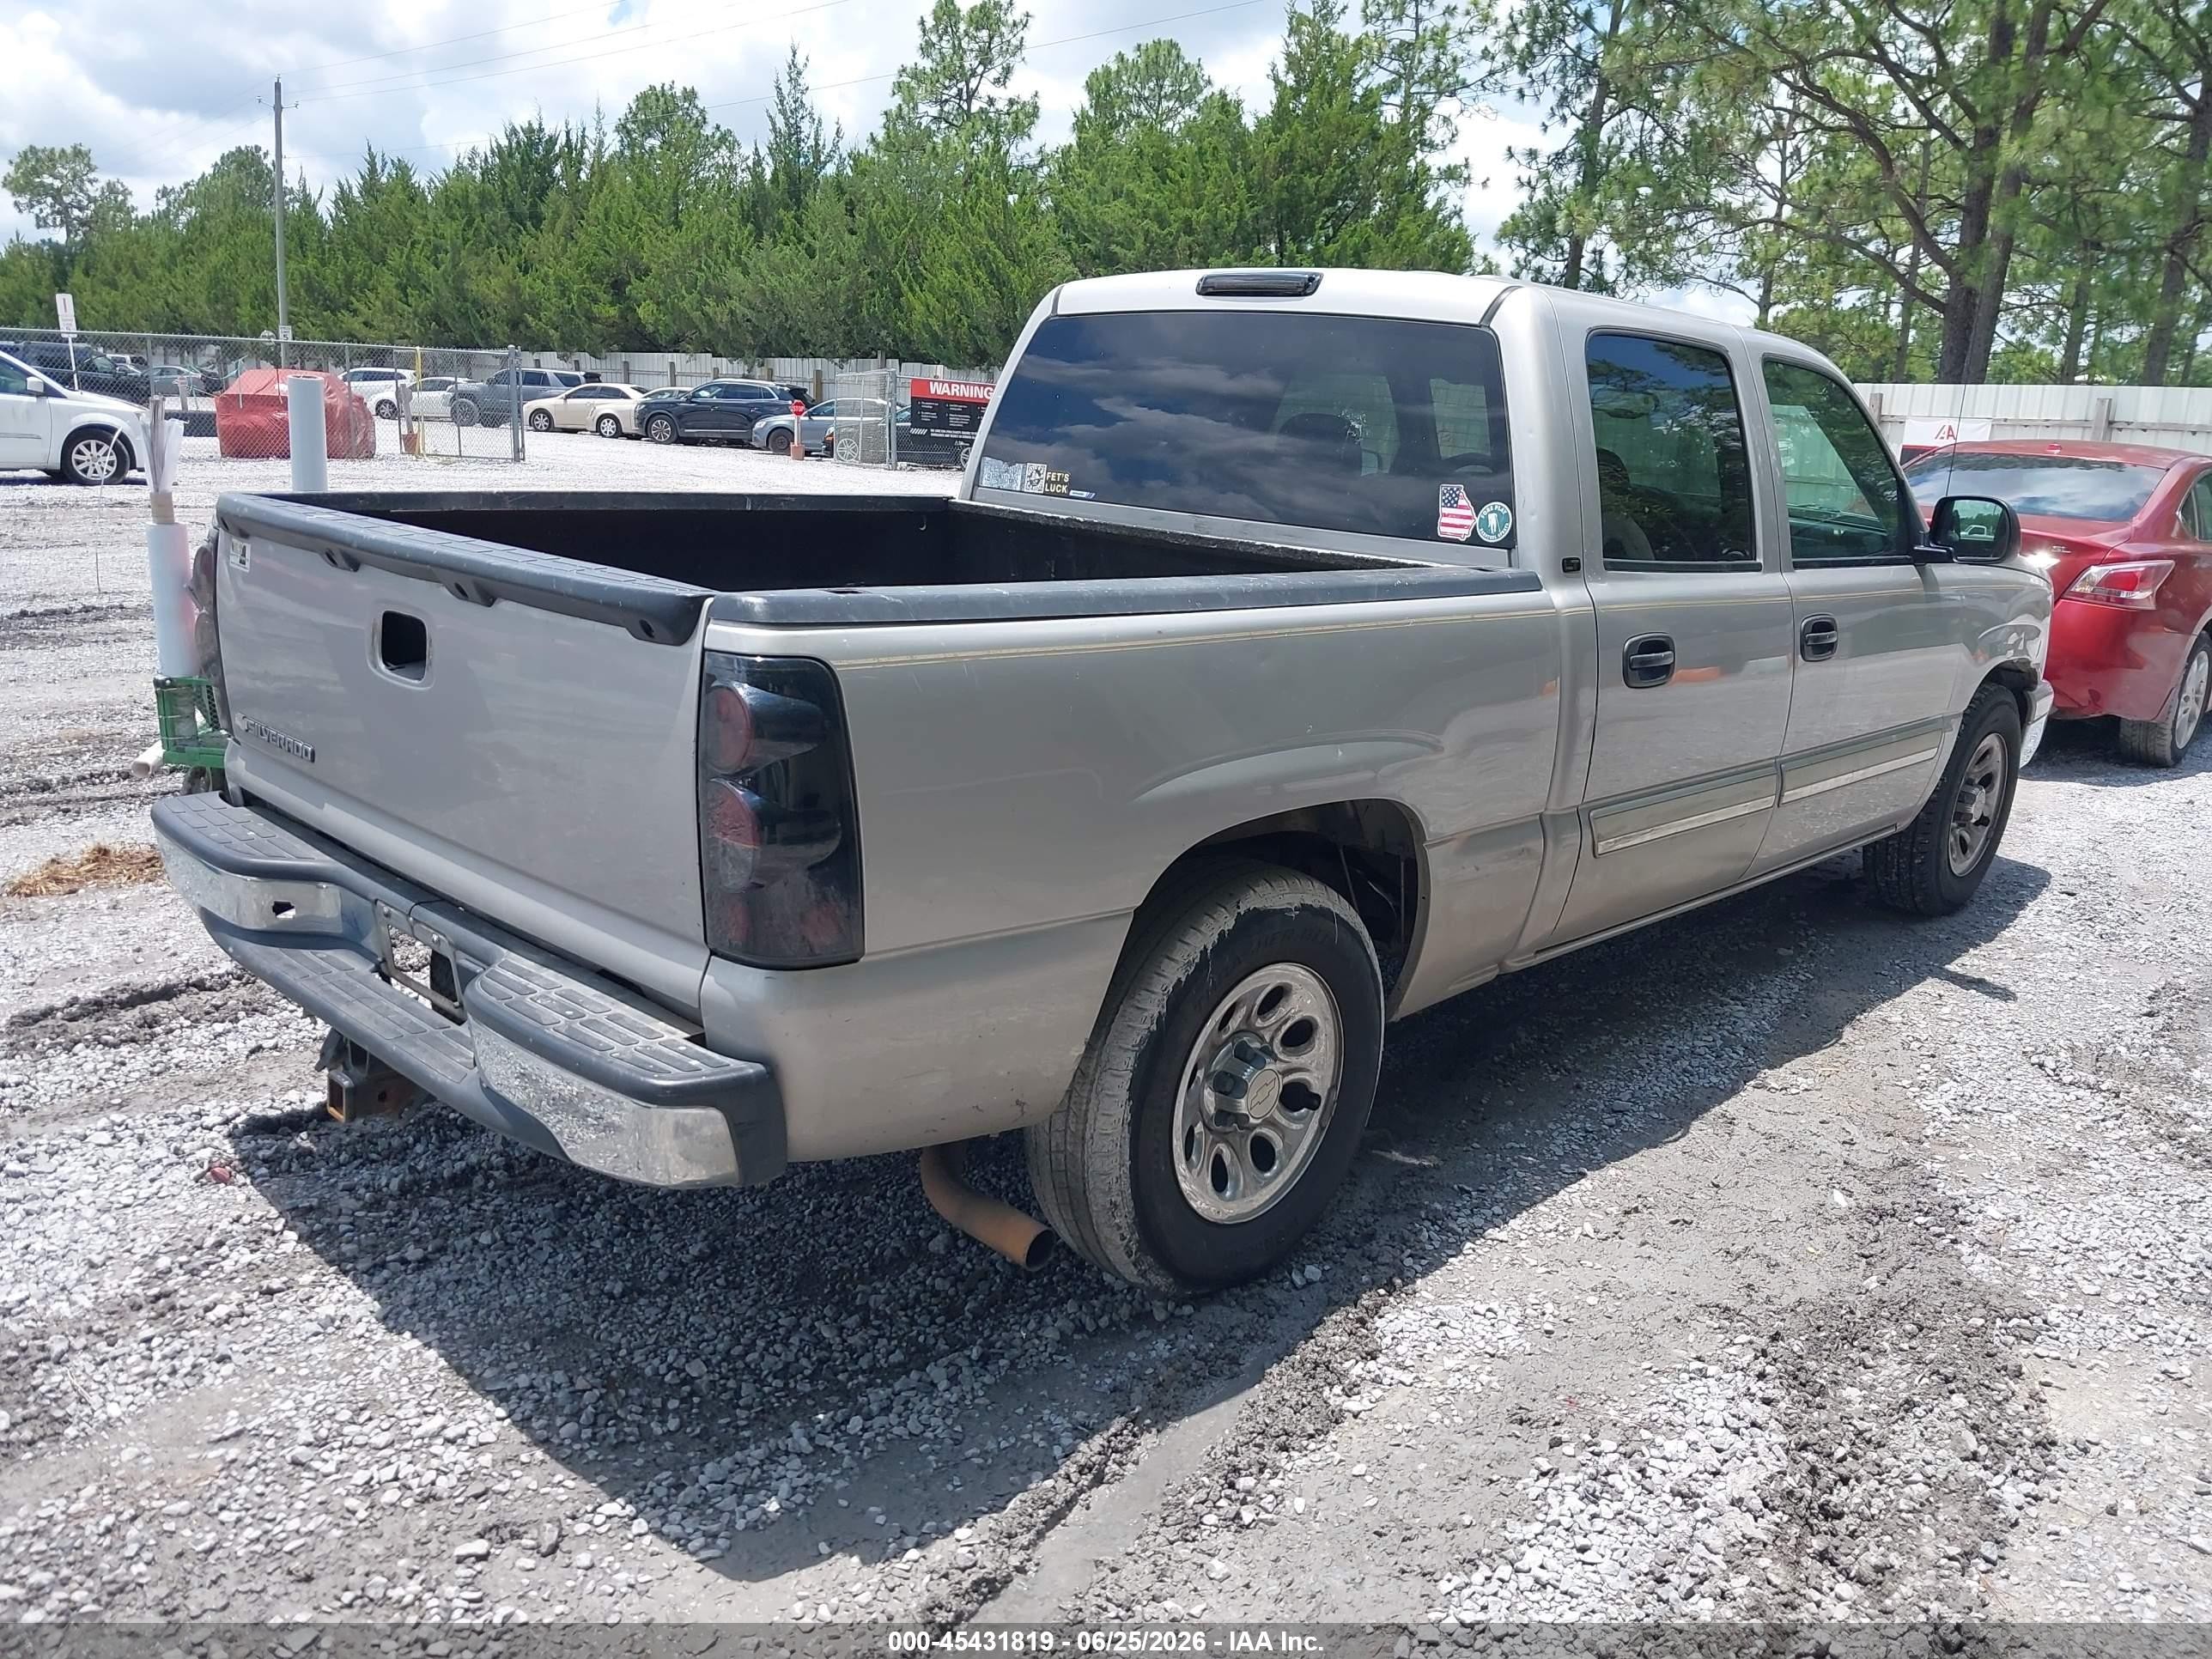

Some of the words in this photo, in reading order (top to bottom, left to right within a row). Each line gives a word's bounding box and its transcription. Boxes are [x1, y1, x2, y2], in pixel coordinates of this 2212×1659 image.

[929, 381, 994, 399] WARNING
[1046, 471, 1070, 482] FET'S
[1045, 483, 1067, 494] LUCK
[1494, 505, 1507, 515] PLAY
[246, 718, 314, 762] SILVERADO
